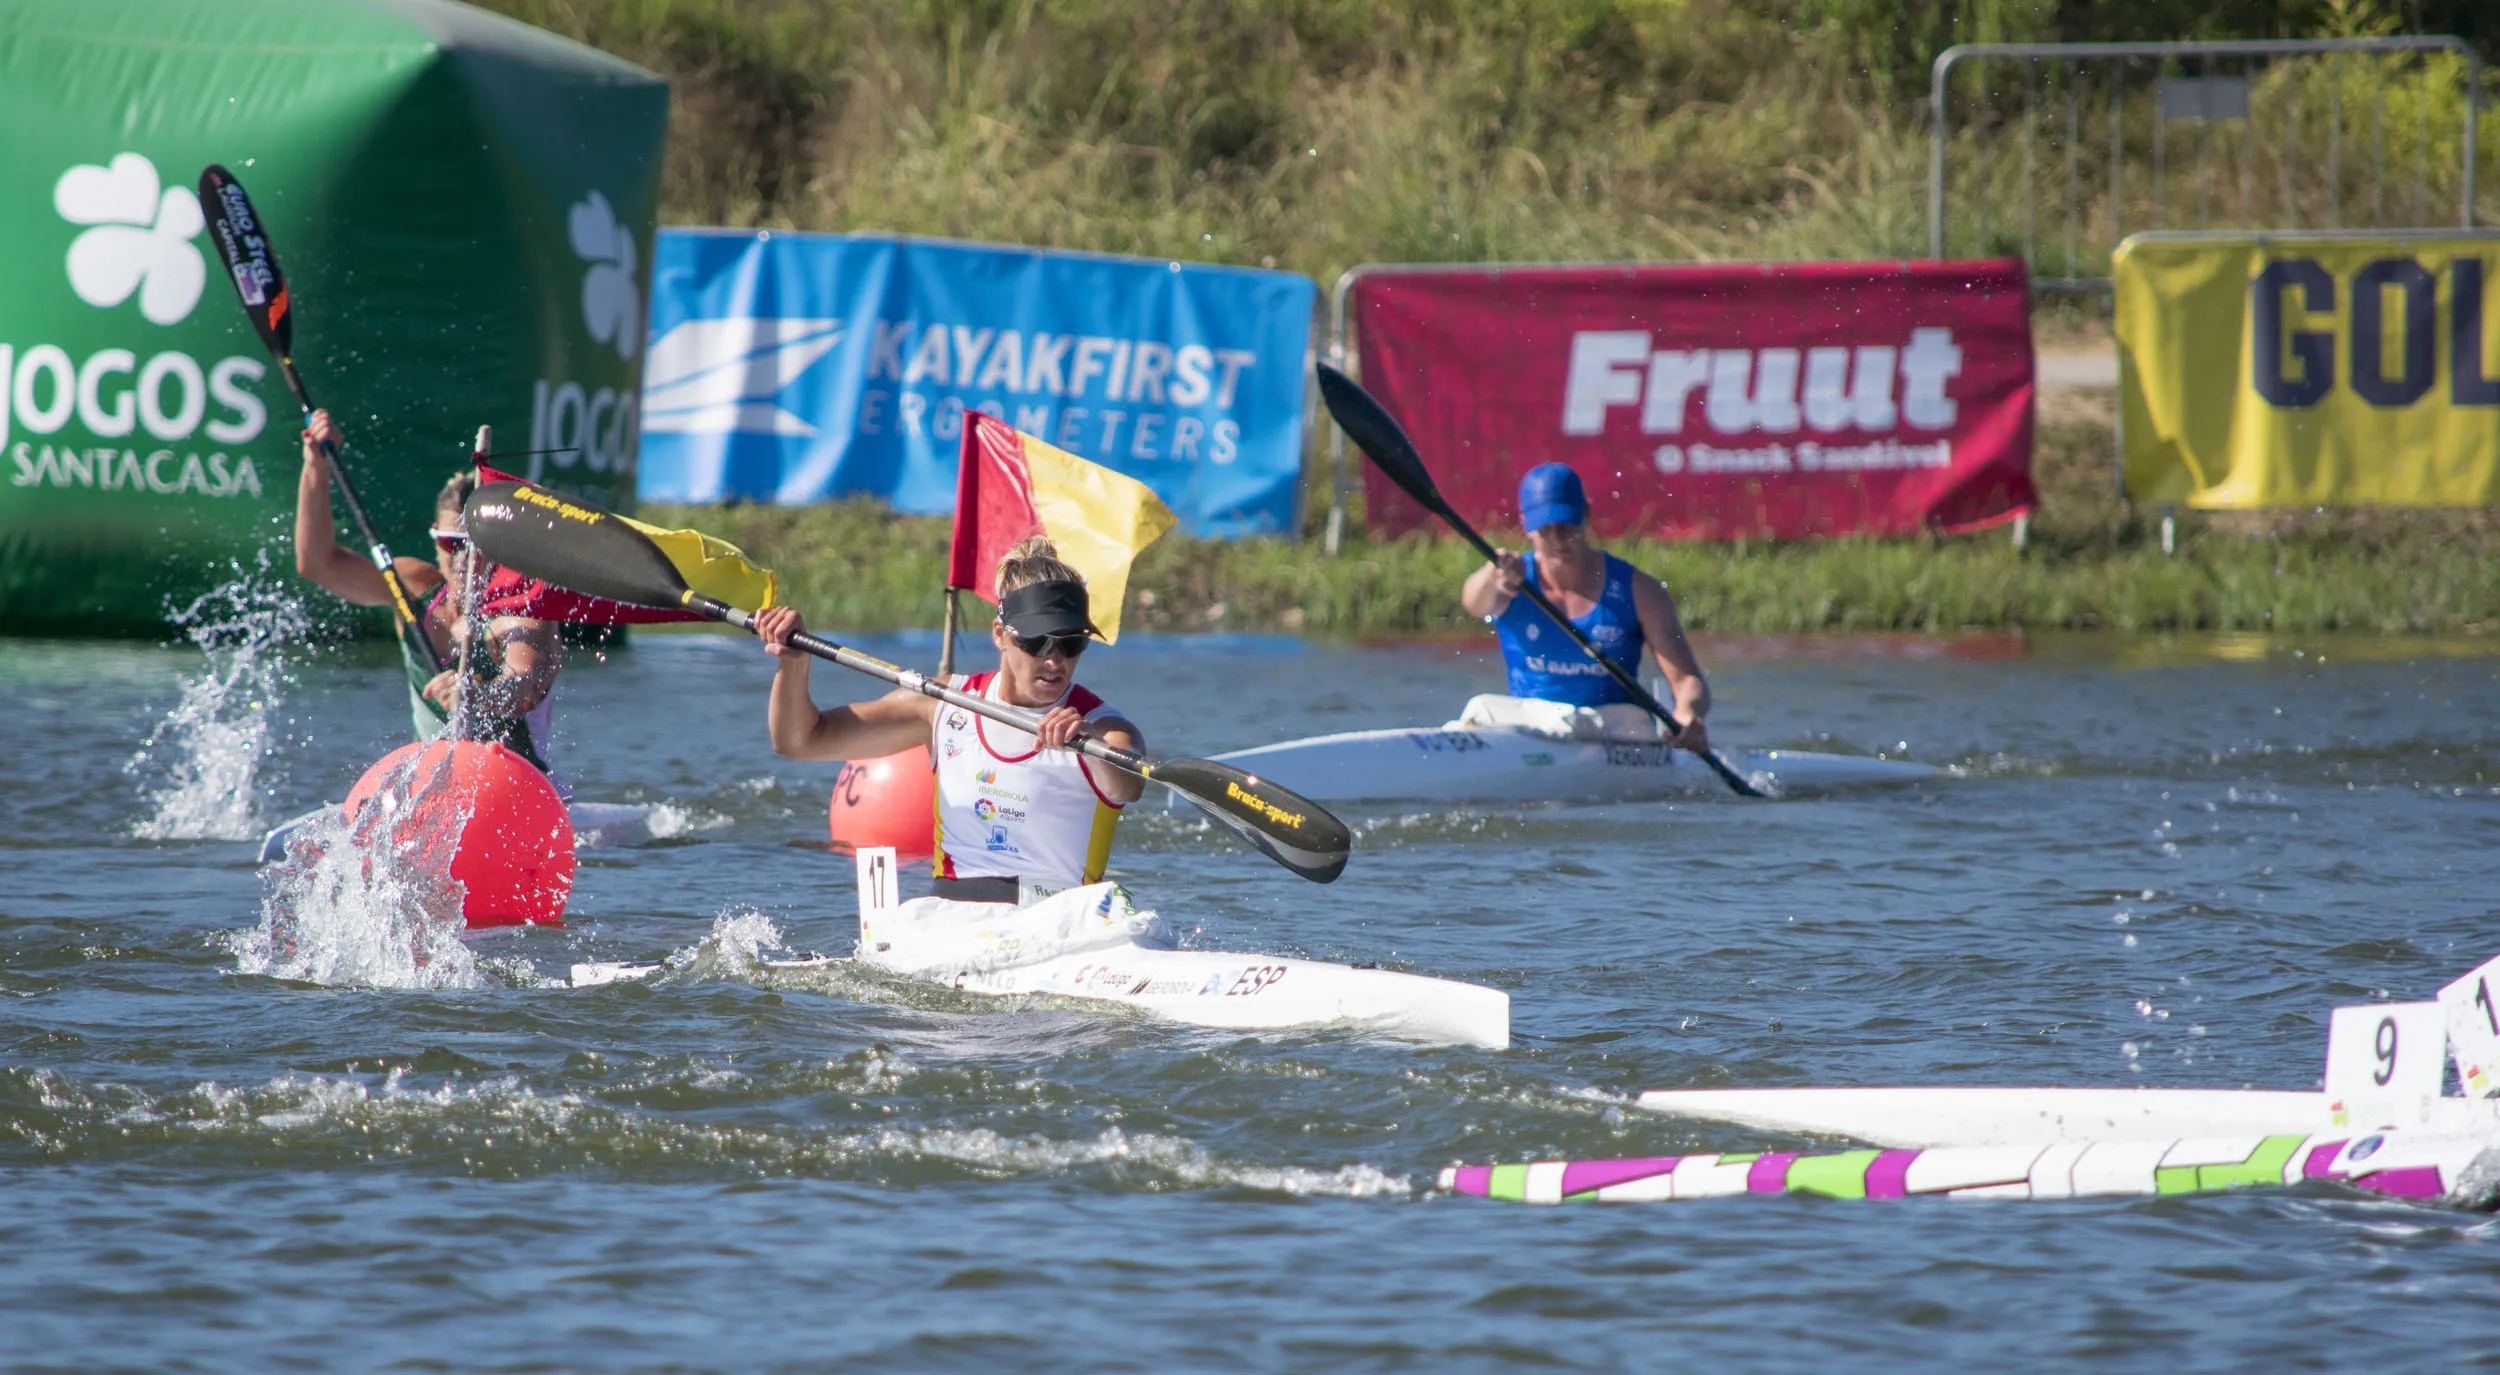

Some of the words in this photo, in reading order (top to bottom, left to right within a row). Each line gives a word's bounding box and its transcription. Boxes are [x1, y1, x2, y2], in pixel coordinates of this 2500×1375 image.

[216, 218, 240, 265] CAPITAL
[2252, 256, 2500, 408] GOL
[866, 318, 1256, 410] KAYAKFIRST
[1562, 326, 1964, 437] Fruut
[0, 342, 267, 457] JOGOS
[978, 785, 1029, 802] IBERDROLA
[998, 805, 1026, 818] LaLiga
[869, 855, 885, 909] 17
[1225, 965, 1288, 996] ESP
[2372, 1015, 2399, 1088] 9
